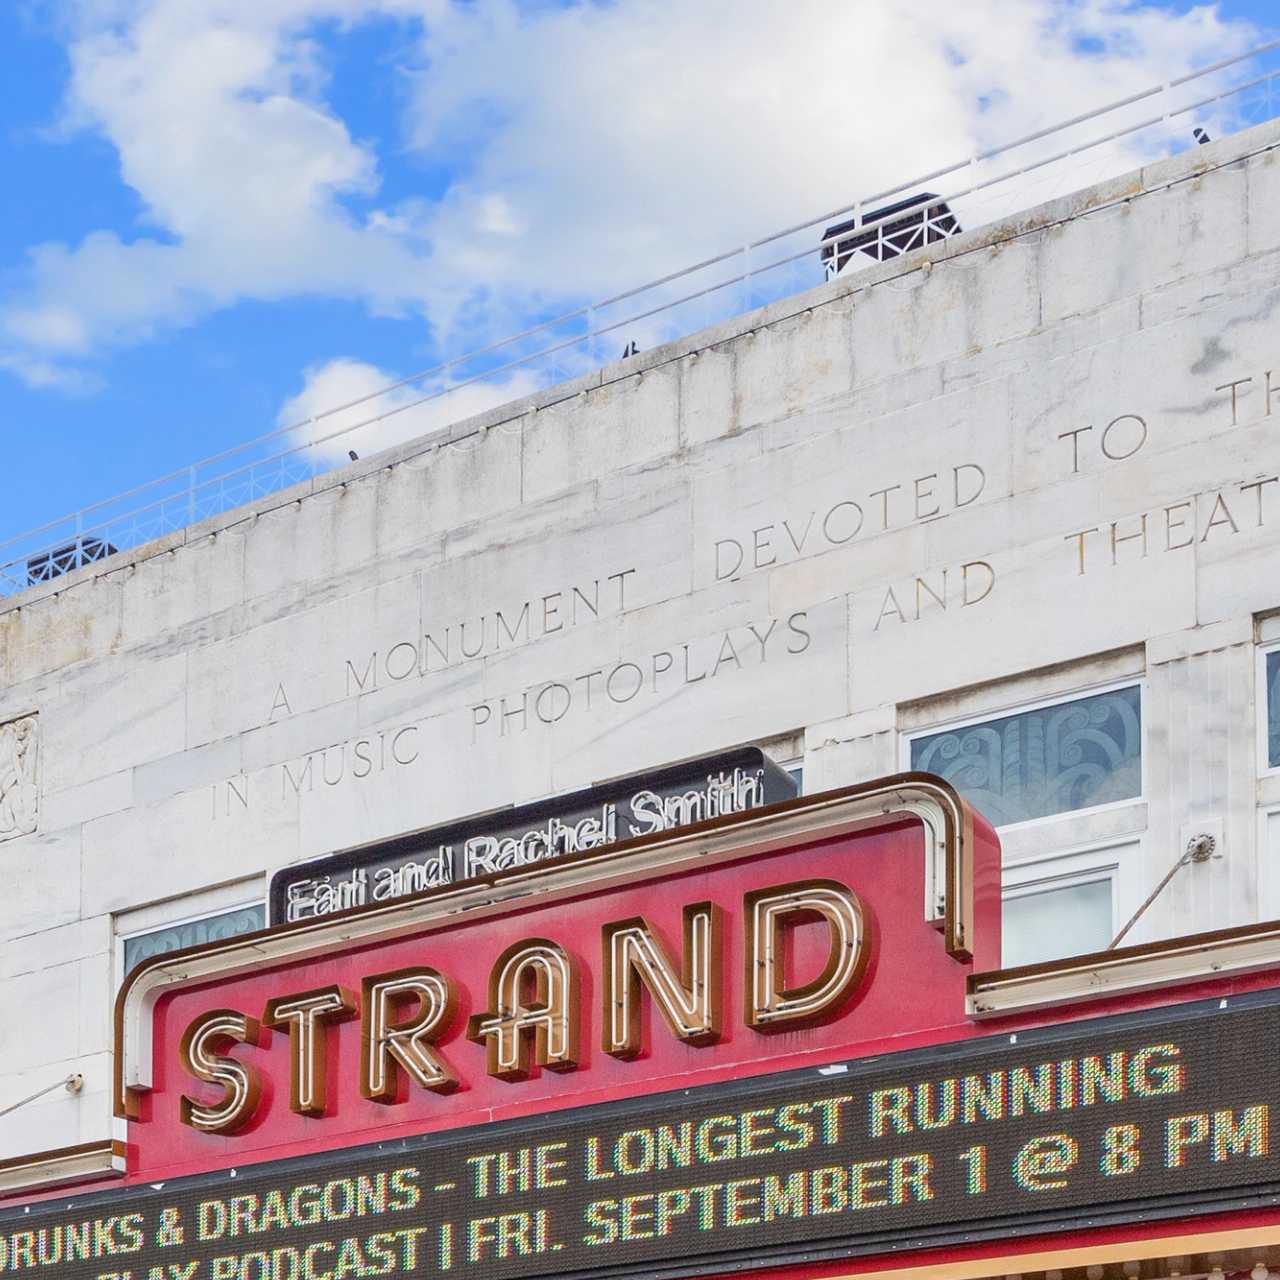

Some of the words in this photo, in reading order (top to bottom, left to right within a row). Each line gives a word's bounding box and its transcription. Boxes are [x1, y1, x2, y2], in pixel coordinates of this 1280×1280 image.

[269, 681, 293, 720] A
[345, 568, 636, 697] MONUMENT
[714, 463, 986, 582] DEVOTED
[1058, 414, 1148, 473] TO
[209, 774, 249, 821] IN
[282, 725, 420, 801] MUSIC
[471, 611, 811, 746] PHOTOPLAYS
[874, 559, 996, 632] AND
[287, 869, 367, 923] Earl
[373, 844, 454, 901] and
[464, 803, 619, 878] Rachel
[629, 768, 765, 837] Smith
[179, 878, 874, 1136] STRAND
[155, 1207, 185, 1248] &
[197, 1167, 422, 1241] DRAGONS
[434, 1182, 457, 1193] -
[466, 1141, 568, 1199] THE
[584, 1095, 854, 1183] LONGEST
[867, 1043, 1187, 1139] RUNNING
[465, 1207, 567, 1264] FRI.
[582, 1151, 936, 1248] SEPTEMBER
[957, 1144, 988, 1195] 1
[1012, 1132, 1080, 1193] @
[1099, 1122, 1142, 1177] 8
[1163, 1103, 1270, 1168] PM
